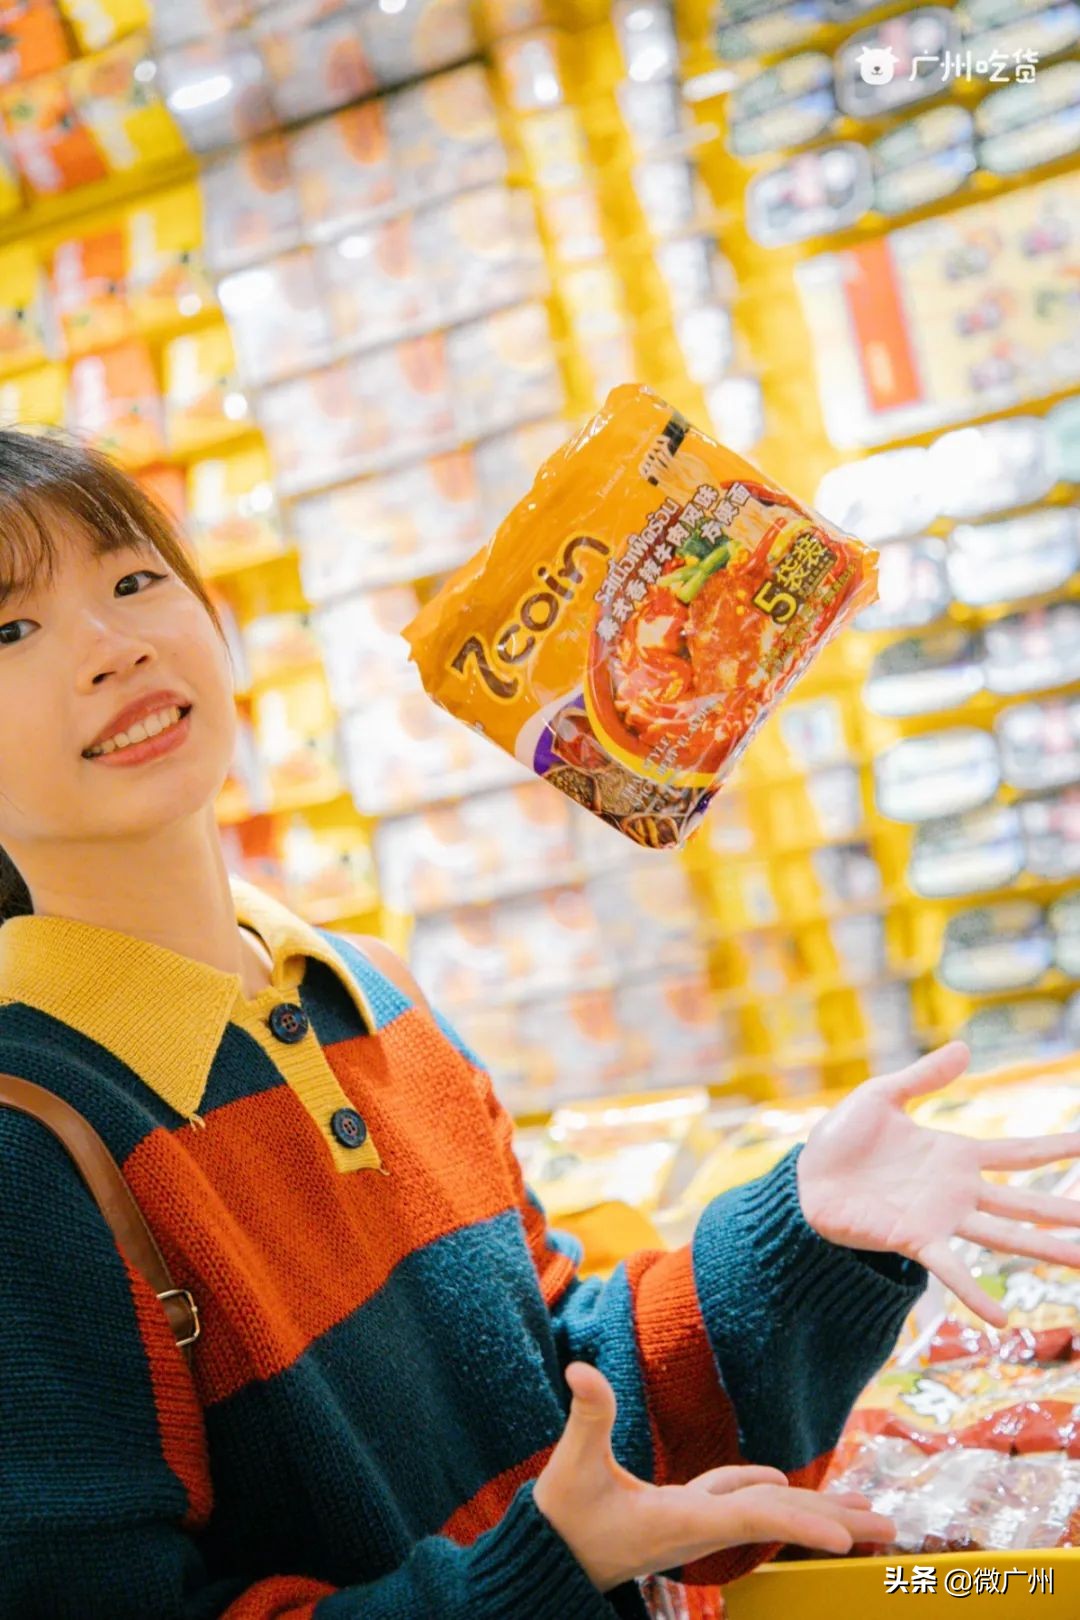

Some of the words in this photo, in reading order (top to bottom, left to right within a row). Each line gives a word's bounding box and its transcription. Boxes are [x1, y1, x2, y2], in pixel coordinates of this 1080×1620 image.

[596, 484, 719, 641] 泰式香辣牛肉风味
[701, 482, 750, 544] 方便面
